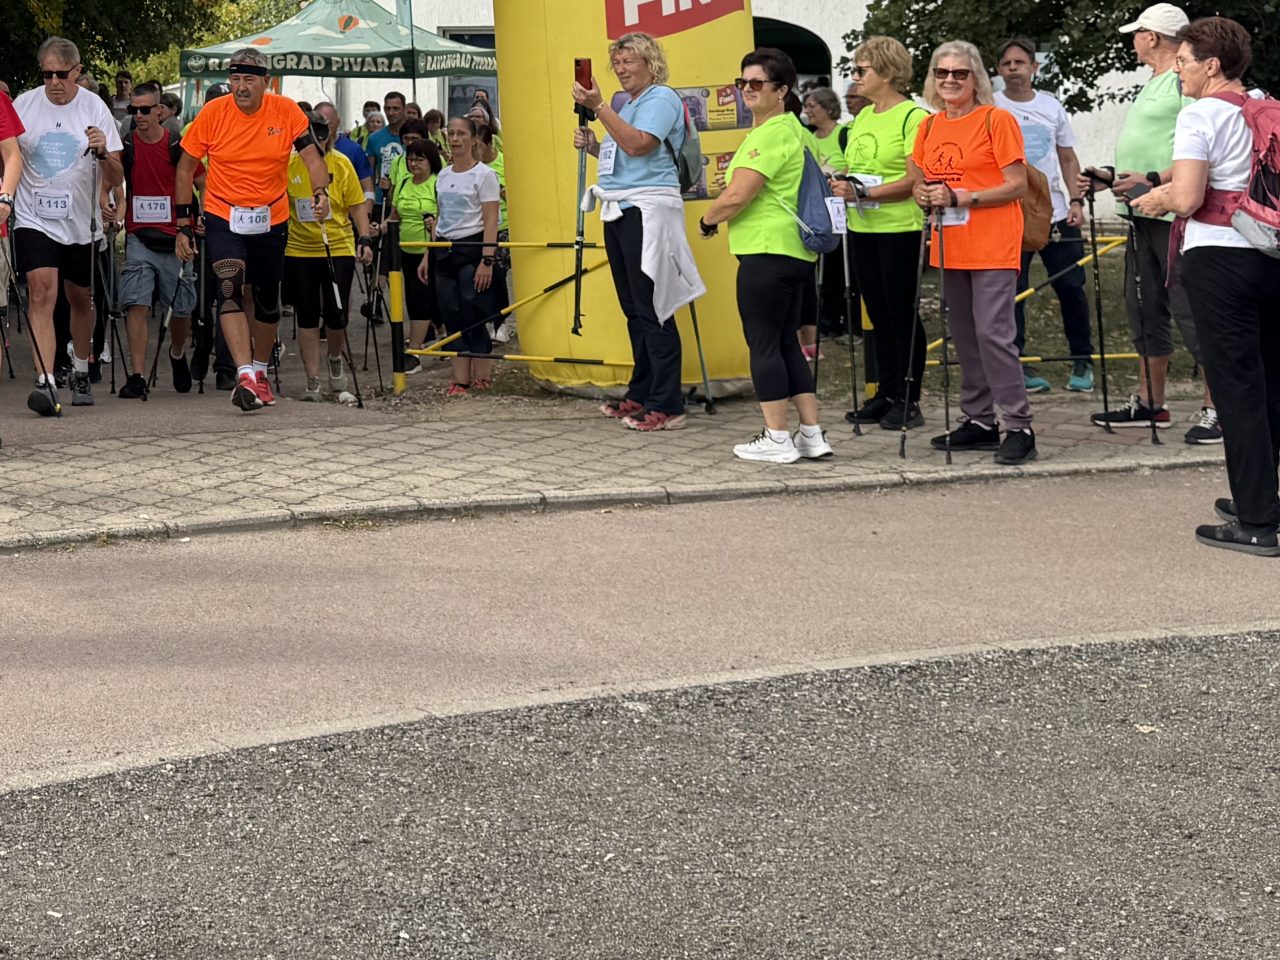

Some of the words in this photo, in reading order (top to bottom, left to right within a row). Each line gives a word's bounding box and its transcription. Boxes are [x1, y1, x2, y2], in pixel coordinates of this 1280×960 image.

[208, 54, 326, 71] RAGRAD
[331, 56, 406, 73] PIVARA
[426, 52, 472, 71] RAVANGRAD
[46, 199, 67, 209] 113
